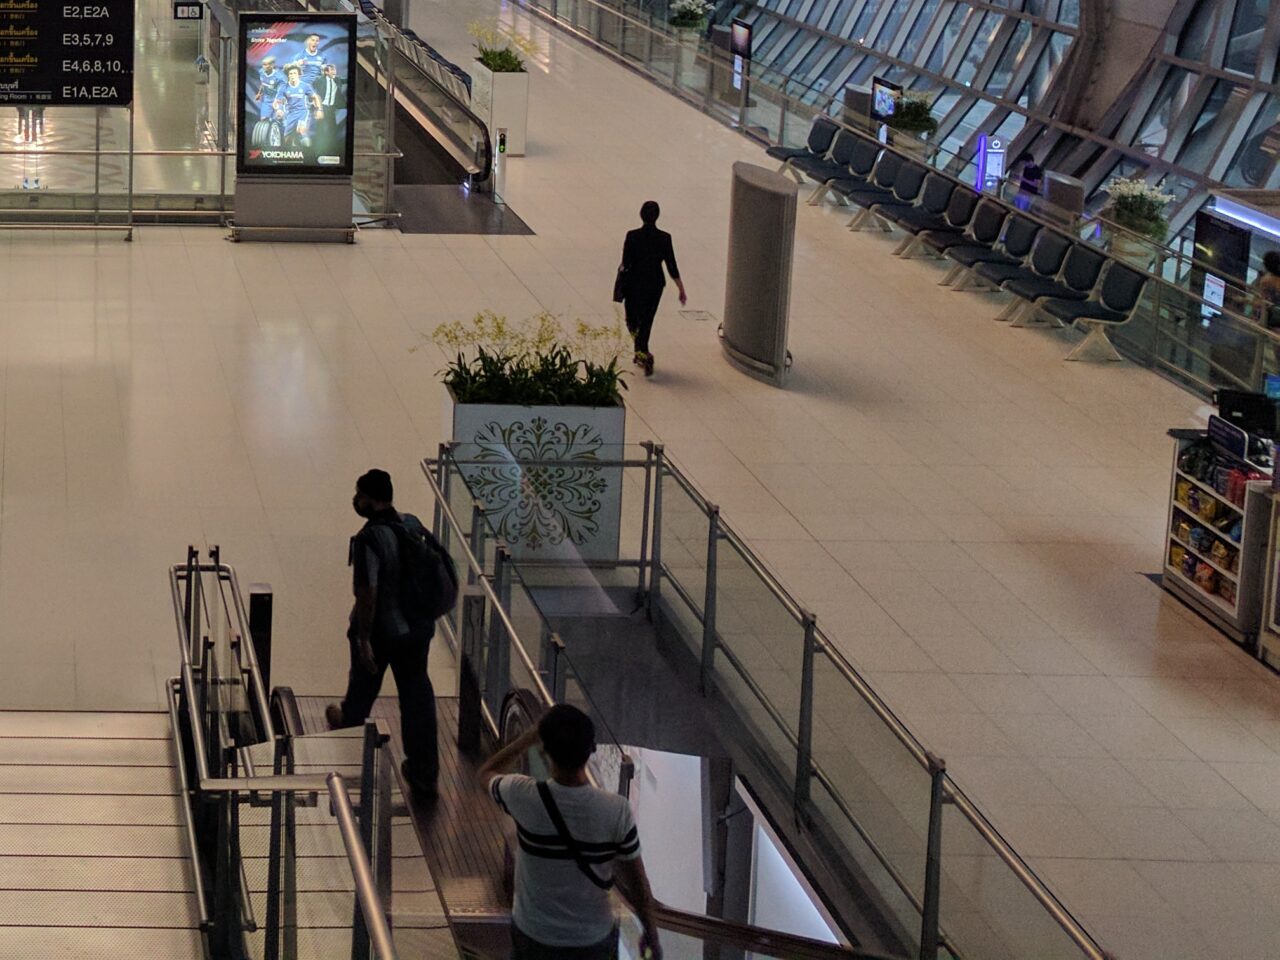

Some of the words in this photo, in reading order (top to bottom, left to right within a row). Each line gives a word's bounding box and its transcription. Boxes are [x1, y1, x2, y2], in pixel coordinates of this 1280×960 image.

[63, 6, 110, 19] E2,E2A
[62, 33, 114, 47] E3,5,7,9
[62, 86, 118, 99] E1A,E2A
[261, 151, 304, 159] YOKOHAMA
